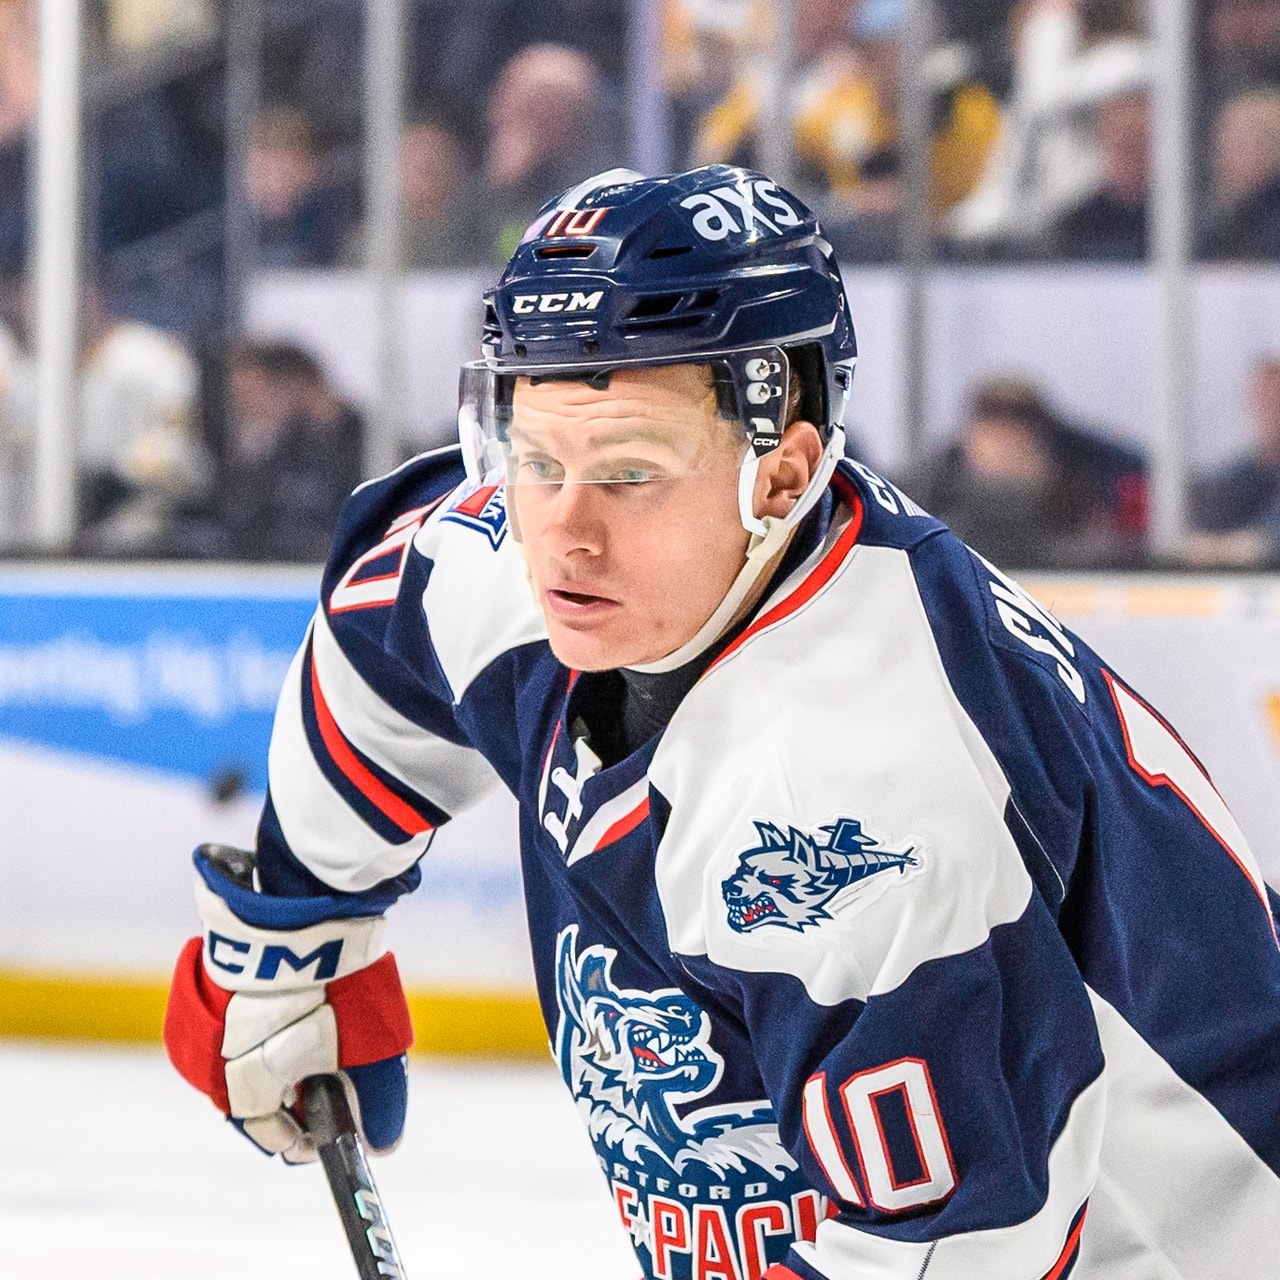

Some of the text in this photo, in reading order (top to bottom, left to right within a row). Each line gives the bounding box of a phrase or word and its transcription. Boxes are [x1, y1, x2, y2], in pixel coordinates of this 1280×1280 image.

[680, 178, 805, 242] axs
[512, 291, 604, 315] CCM
[753, 438, 779, 447] CCM
[208, 930, 344, 981] CM
[802, 1056, 959, 1212] 10
